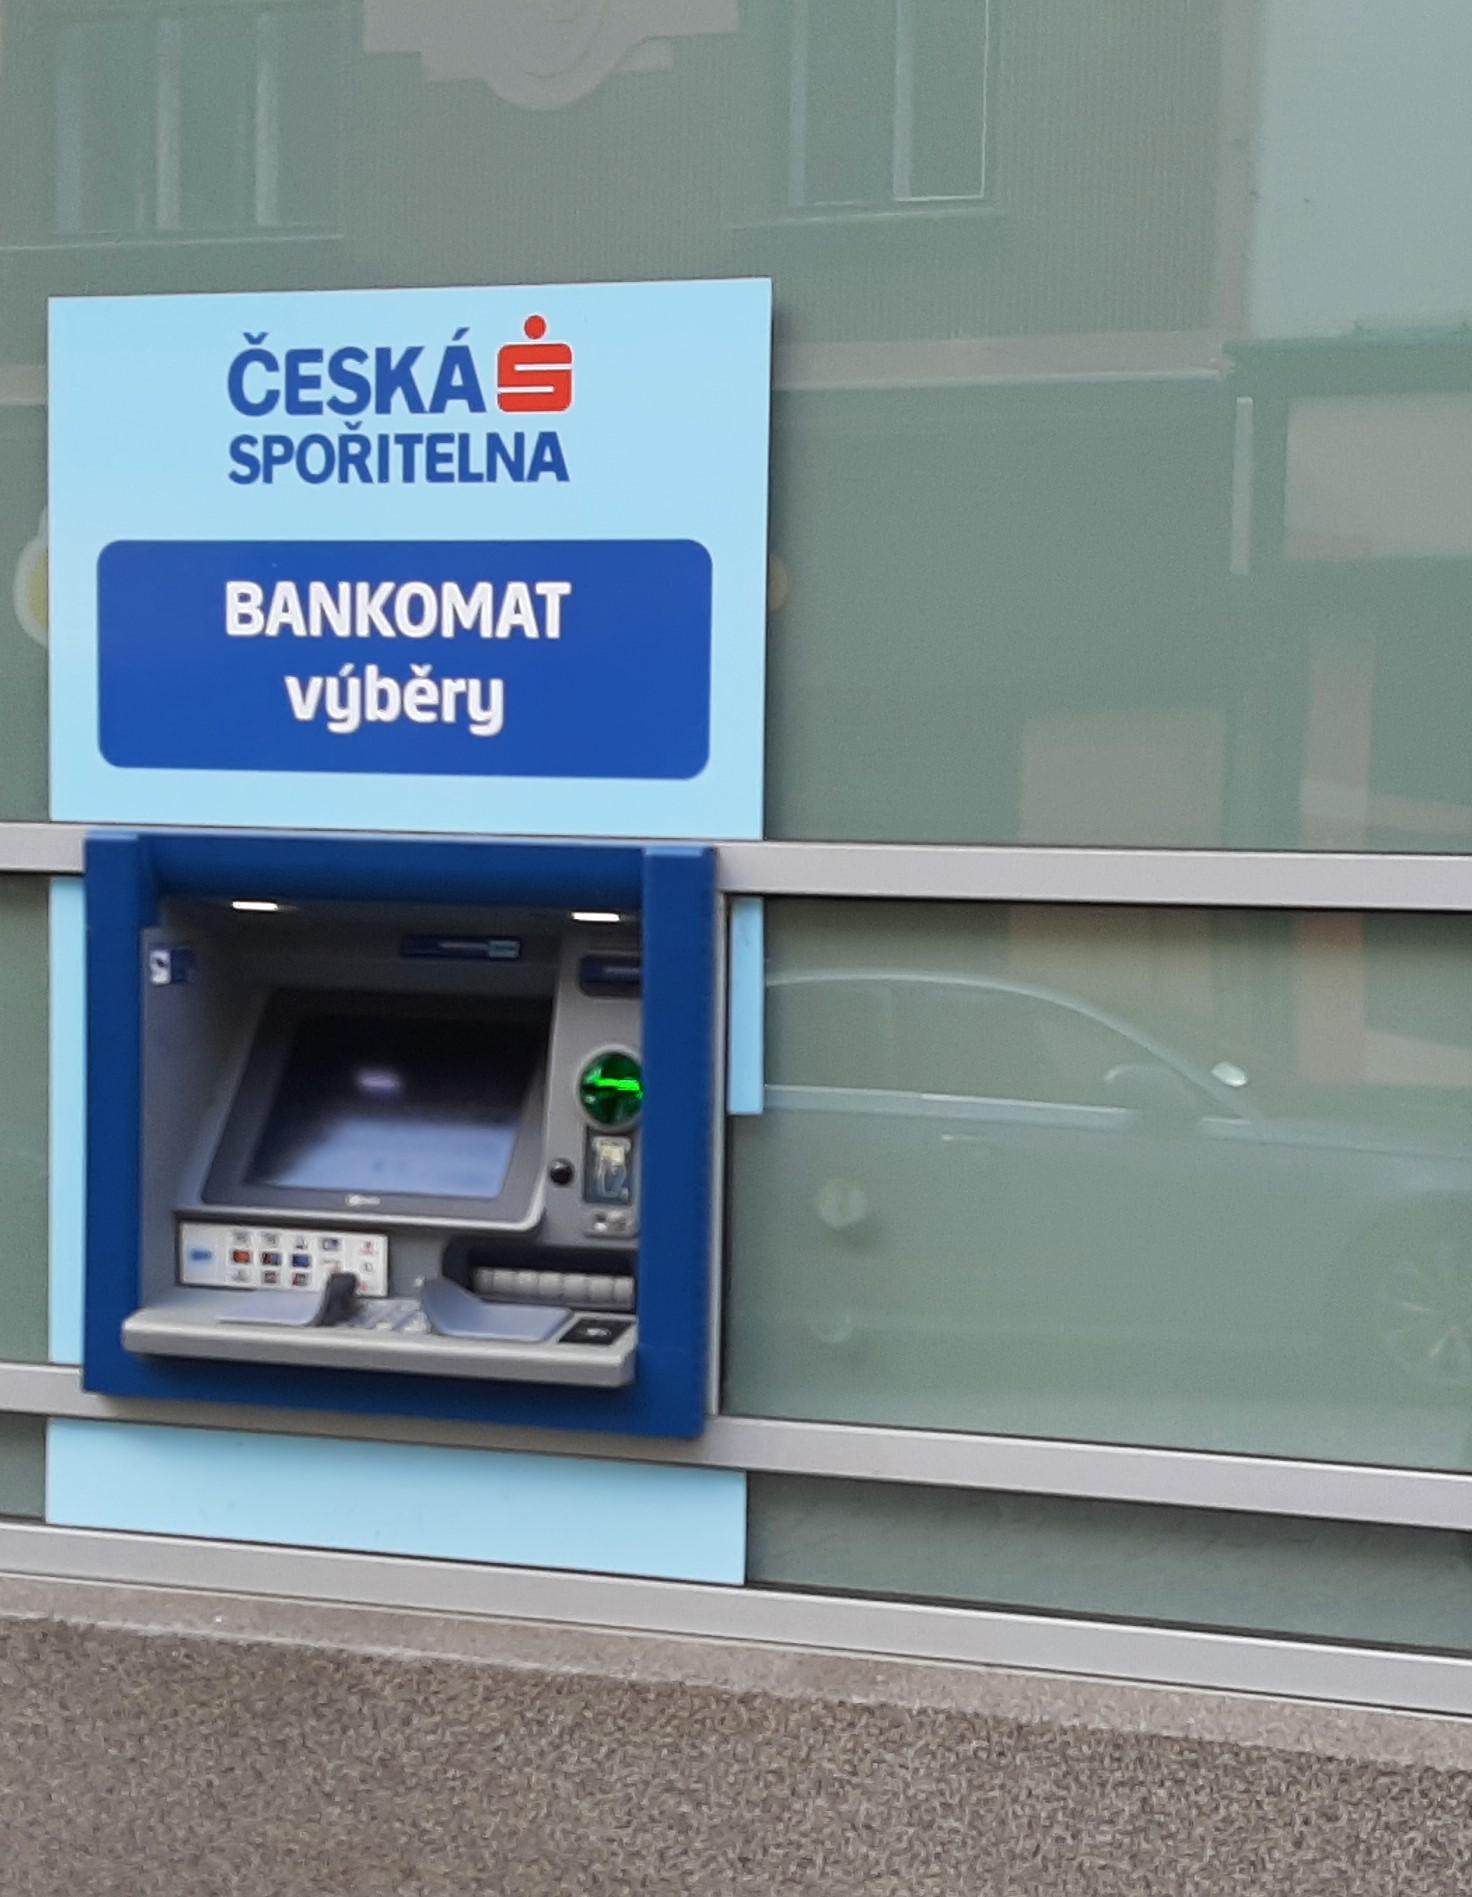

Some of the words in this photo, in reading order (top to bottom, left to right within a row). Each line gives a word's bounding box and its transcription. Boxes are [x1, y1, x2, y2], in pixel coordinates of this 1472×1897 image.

[226, 326, 487, 417] ČESKÁ
[227, 420, 571, 486] SPOŘITELNA
[224, 579, 573, 639] BANKOMAT
[284, 662, 504, 737] výběry
